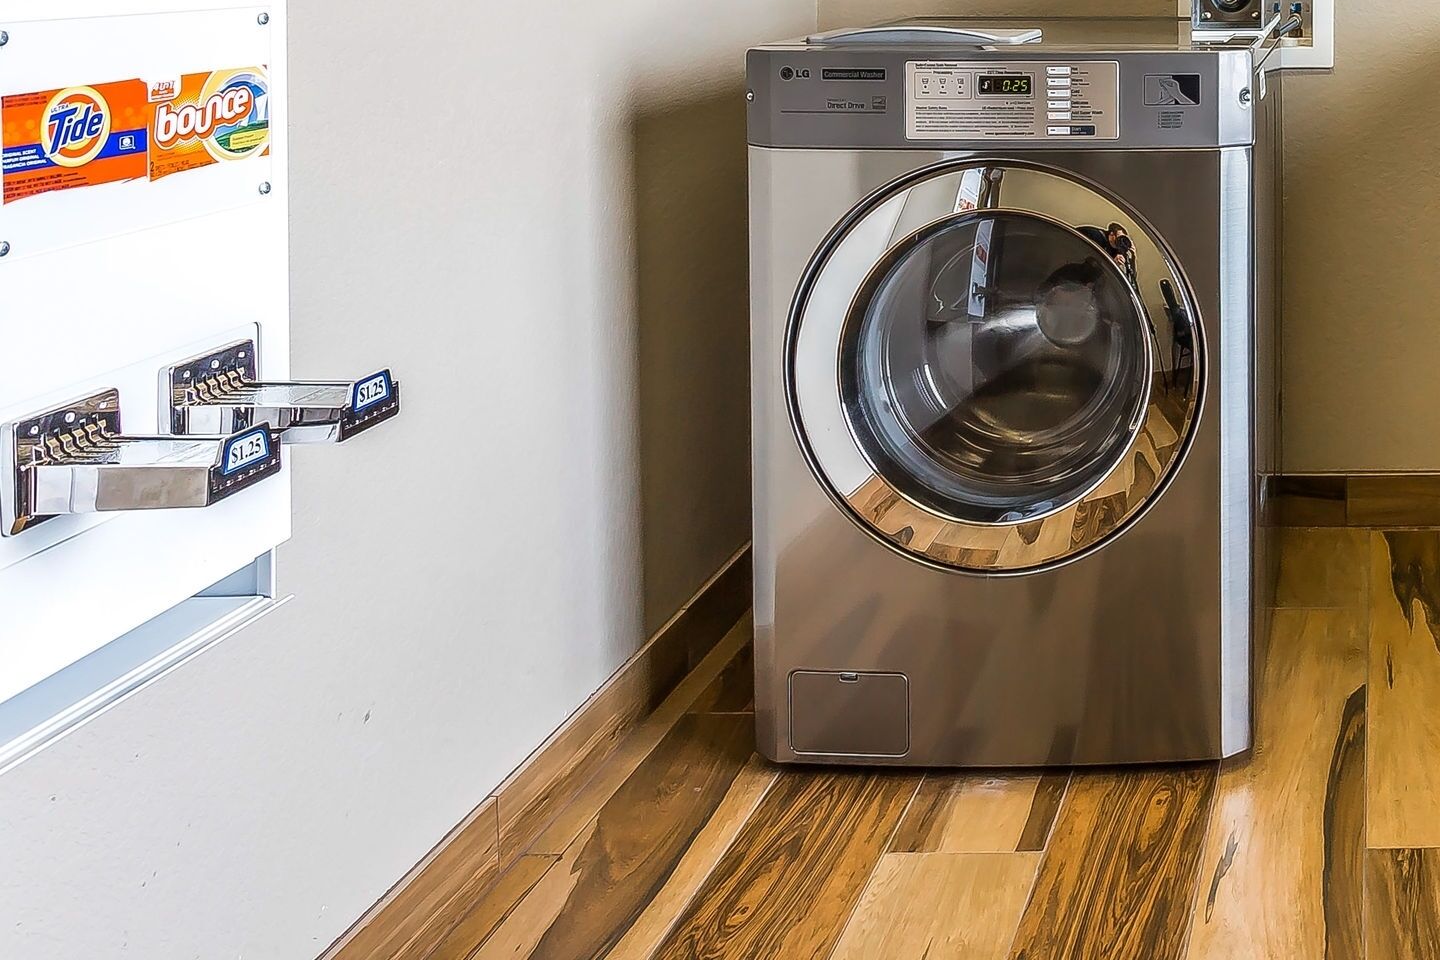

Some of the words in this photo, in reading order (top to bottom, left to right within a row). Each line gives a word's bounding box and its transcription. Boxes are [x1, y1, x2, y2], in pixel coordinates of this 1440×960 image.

[823, 70, 859, 79] Commercial
[860, 70, 884, 79] Washer
[48, 105, 104, 155] Tide
[154, 87, 252, 145] bounce
[359, 381, 385, 404] $1.25
[230, 437, 263, 465] $1.25
